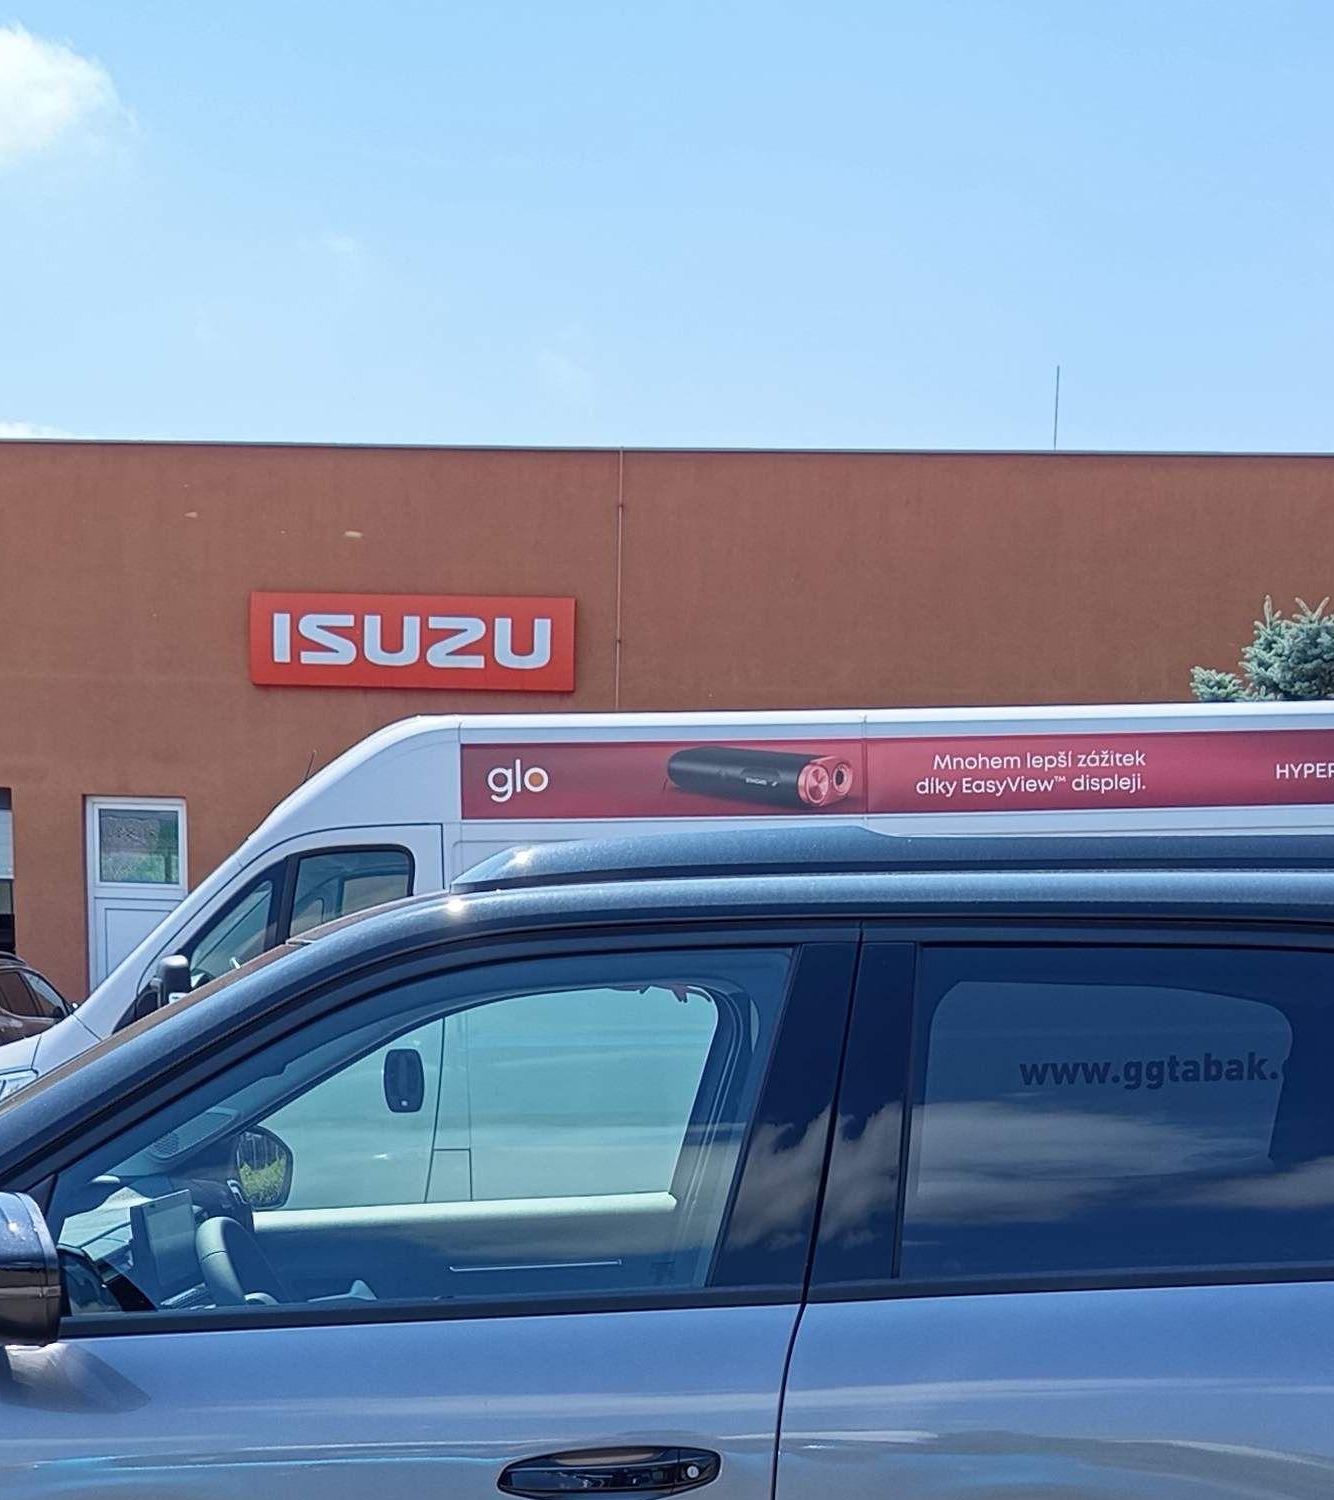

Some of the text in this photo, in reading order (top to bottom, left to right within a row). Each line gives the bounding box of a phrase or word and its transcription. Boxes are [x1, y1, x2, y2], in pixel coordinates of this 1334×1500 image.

[273, 613, 552, 670] ISUZU
[933, 749, 1147, 772] Mnohem lepší zážitek
[487, 758, 549, 803] glo
[916, 776, 957, 797] díky
[1071, 773, 1147, 794] displeji.
[1019, 1052, 1291, 1090] www.ggtabak.
